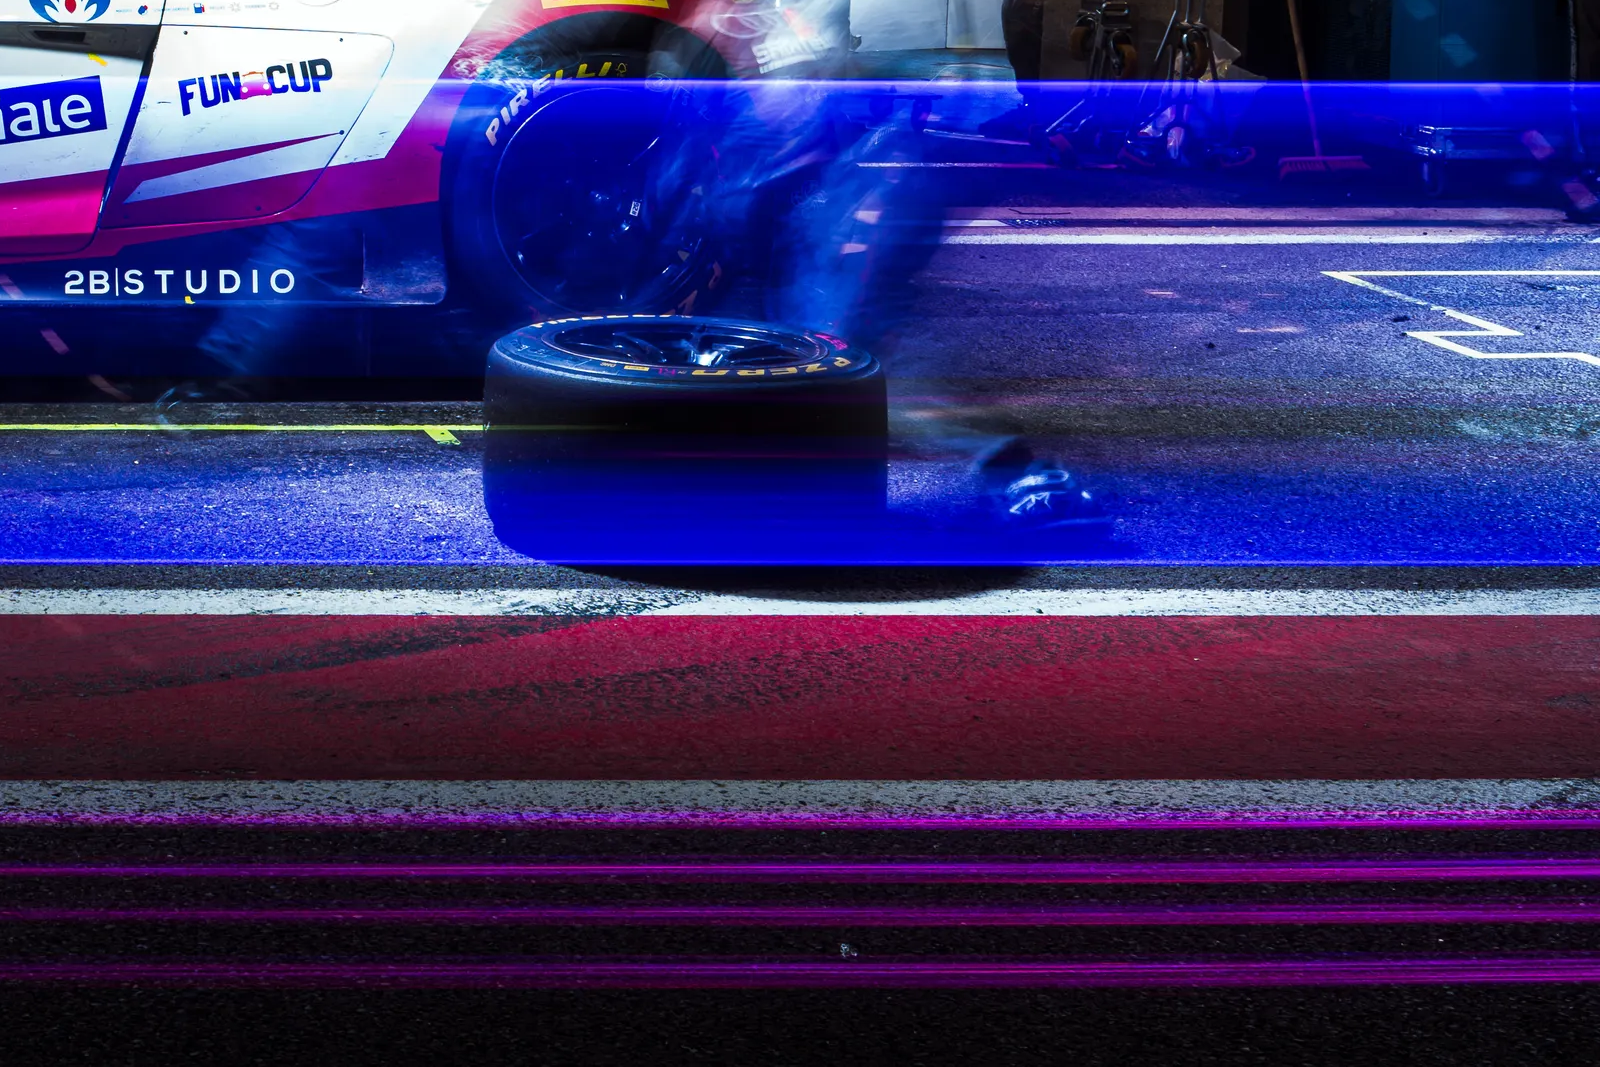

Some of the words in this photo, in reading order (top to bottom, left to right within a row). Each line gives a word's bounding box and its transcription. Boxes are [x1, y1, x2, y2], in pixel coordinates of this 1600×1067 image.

[177, 71, 242, 117] FUN
[266, 58, 333, 94] CUP
[485, 61, 613, 147] PIRELLI
